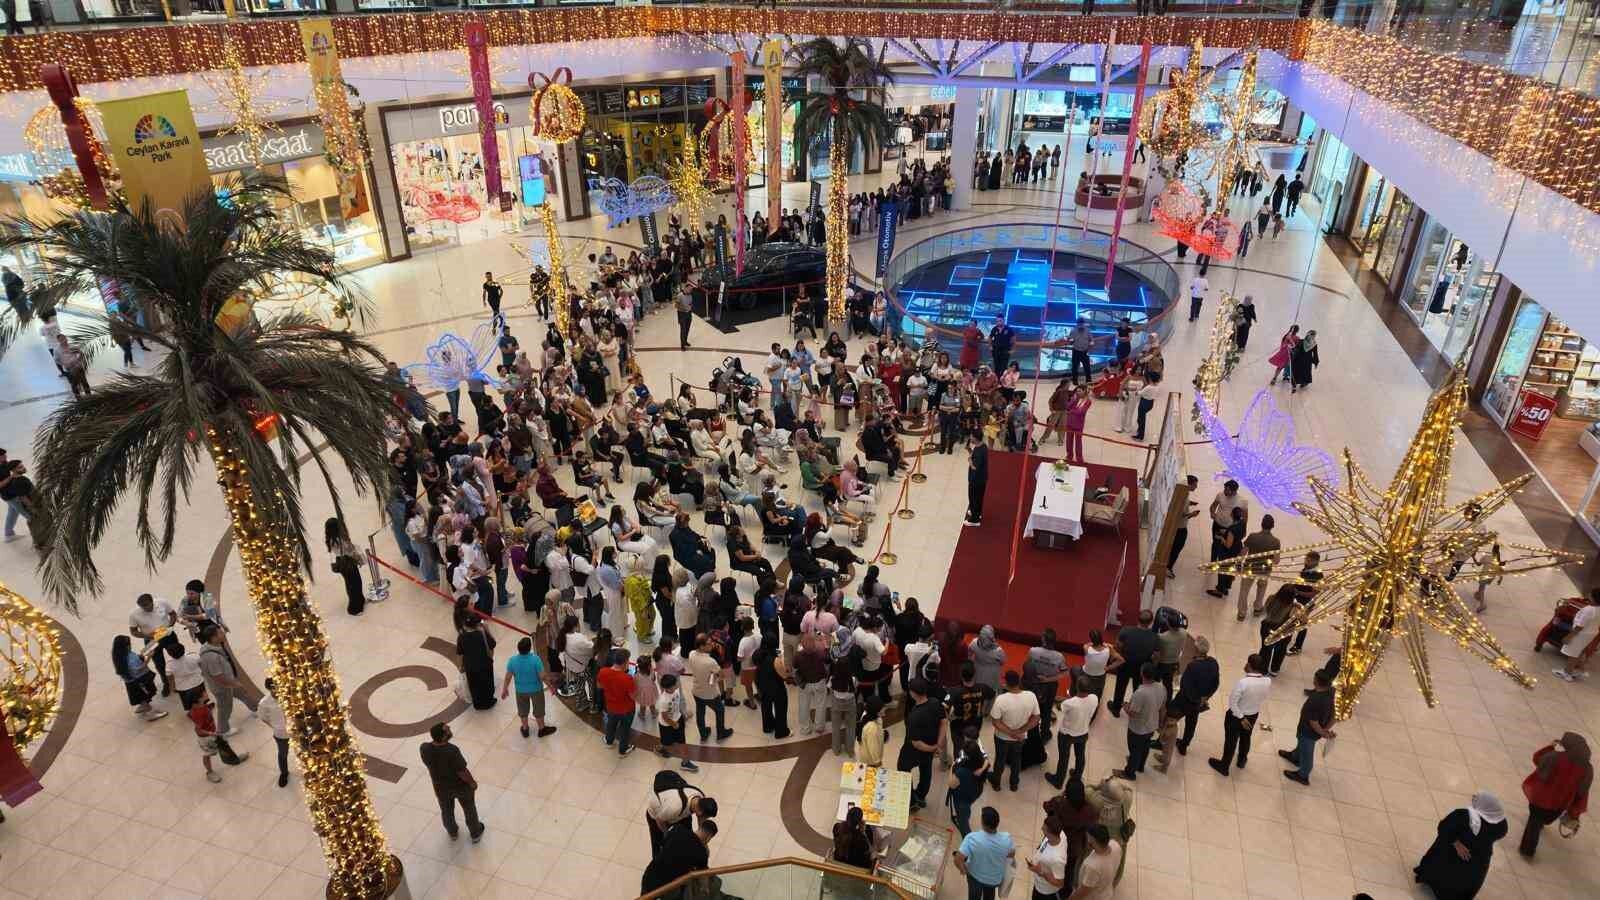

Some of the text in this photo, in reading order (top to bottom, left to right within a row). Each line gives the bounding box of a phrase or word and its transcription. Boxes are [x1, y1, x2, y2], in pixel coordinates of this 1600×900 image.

[126, 143, 159, 157] Ceylan
[151, 151, 173, 163] Park
[1520, 406, 1551, 422] %50
